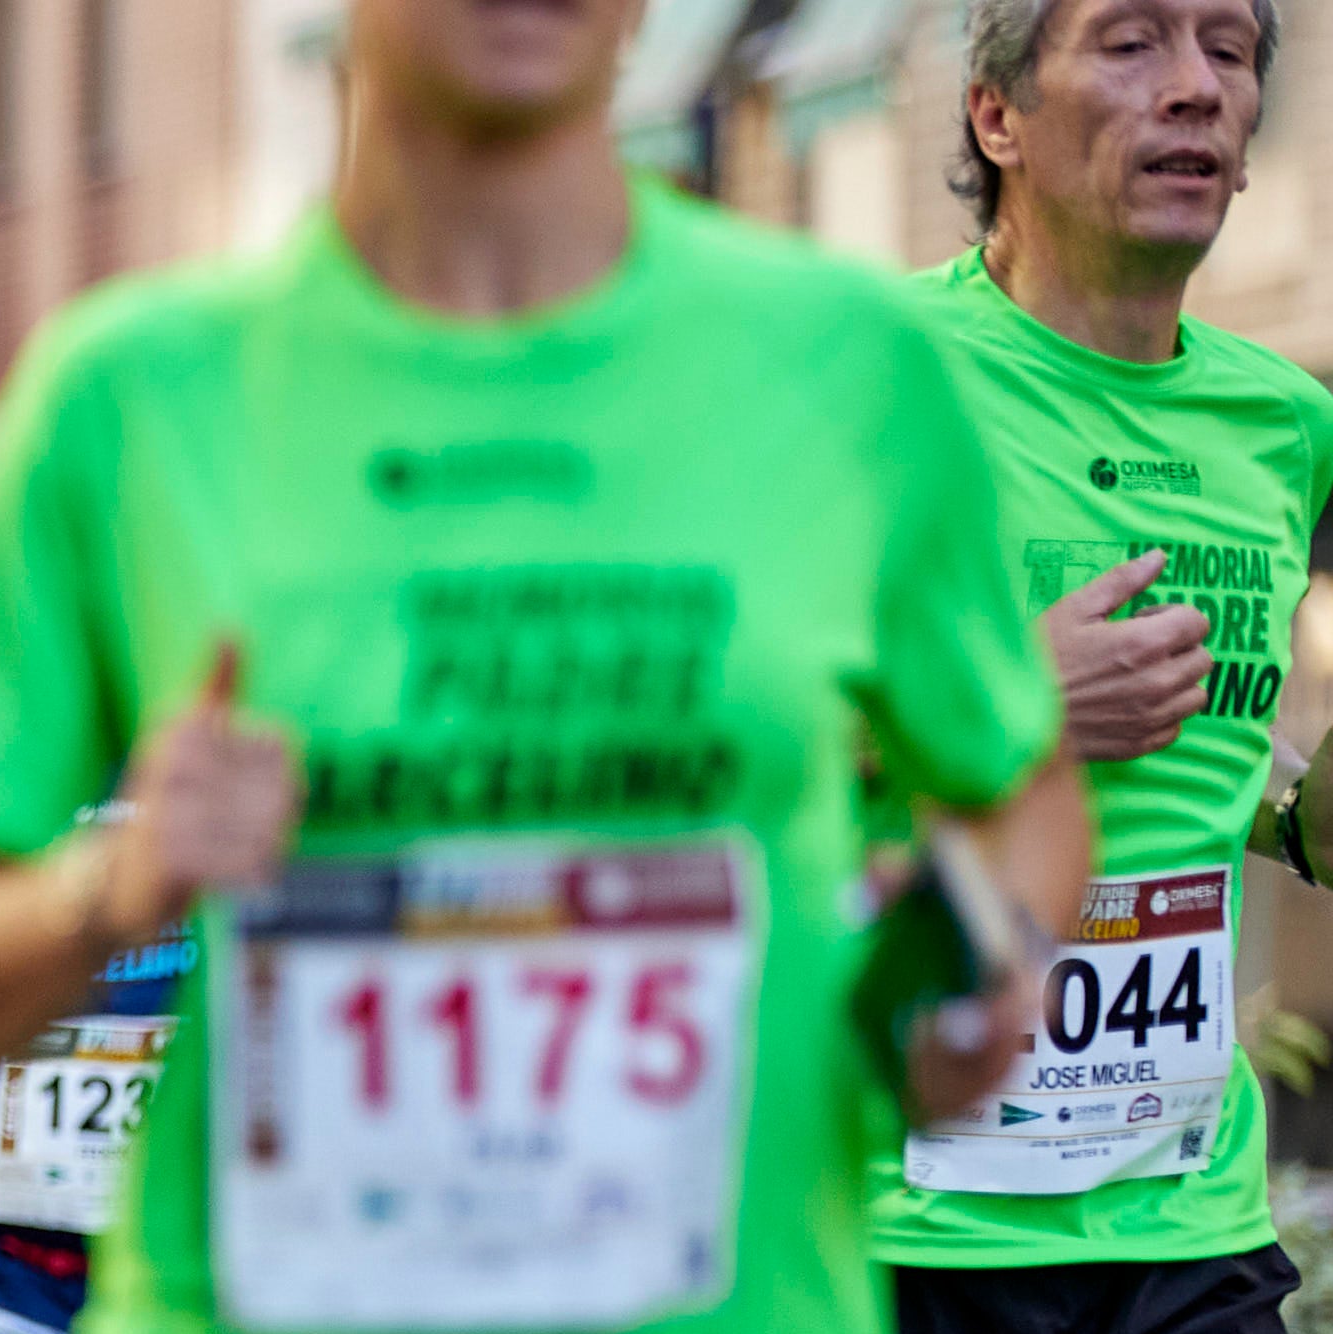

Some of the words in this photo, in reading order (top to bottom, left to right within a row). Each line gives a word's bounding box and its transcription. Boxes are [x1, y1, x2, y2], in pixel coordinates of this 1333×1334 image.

[1121, 460, 1200, 480] OXIMESA
[1131, 592, 1270, 653] DRE
[332, 962, 705, 1112] 1175
[1030, 1066, 1089, 1089] JOSE
[1090, 1059, 1161, 1086] MIGUEL
